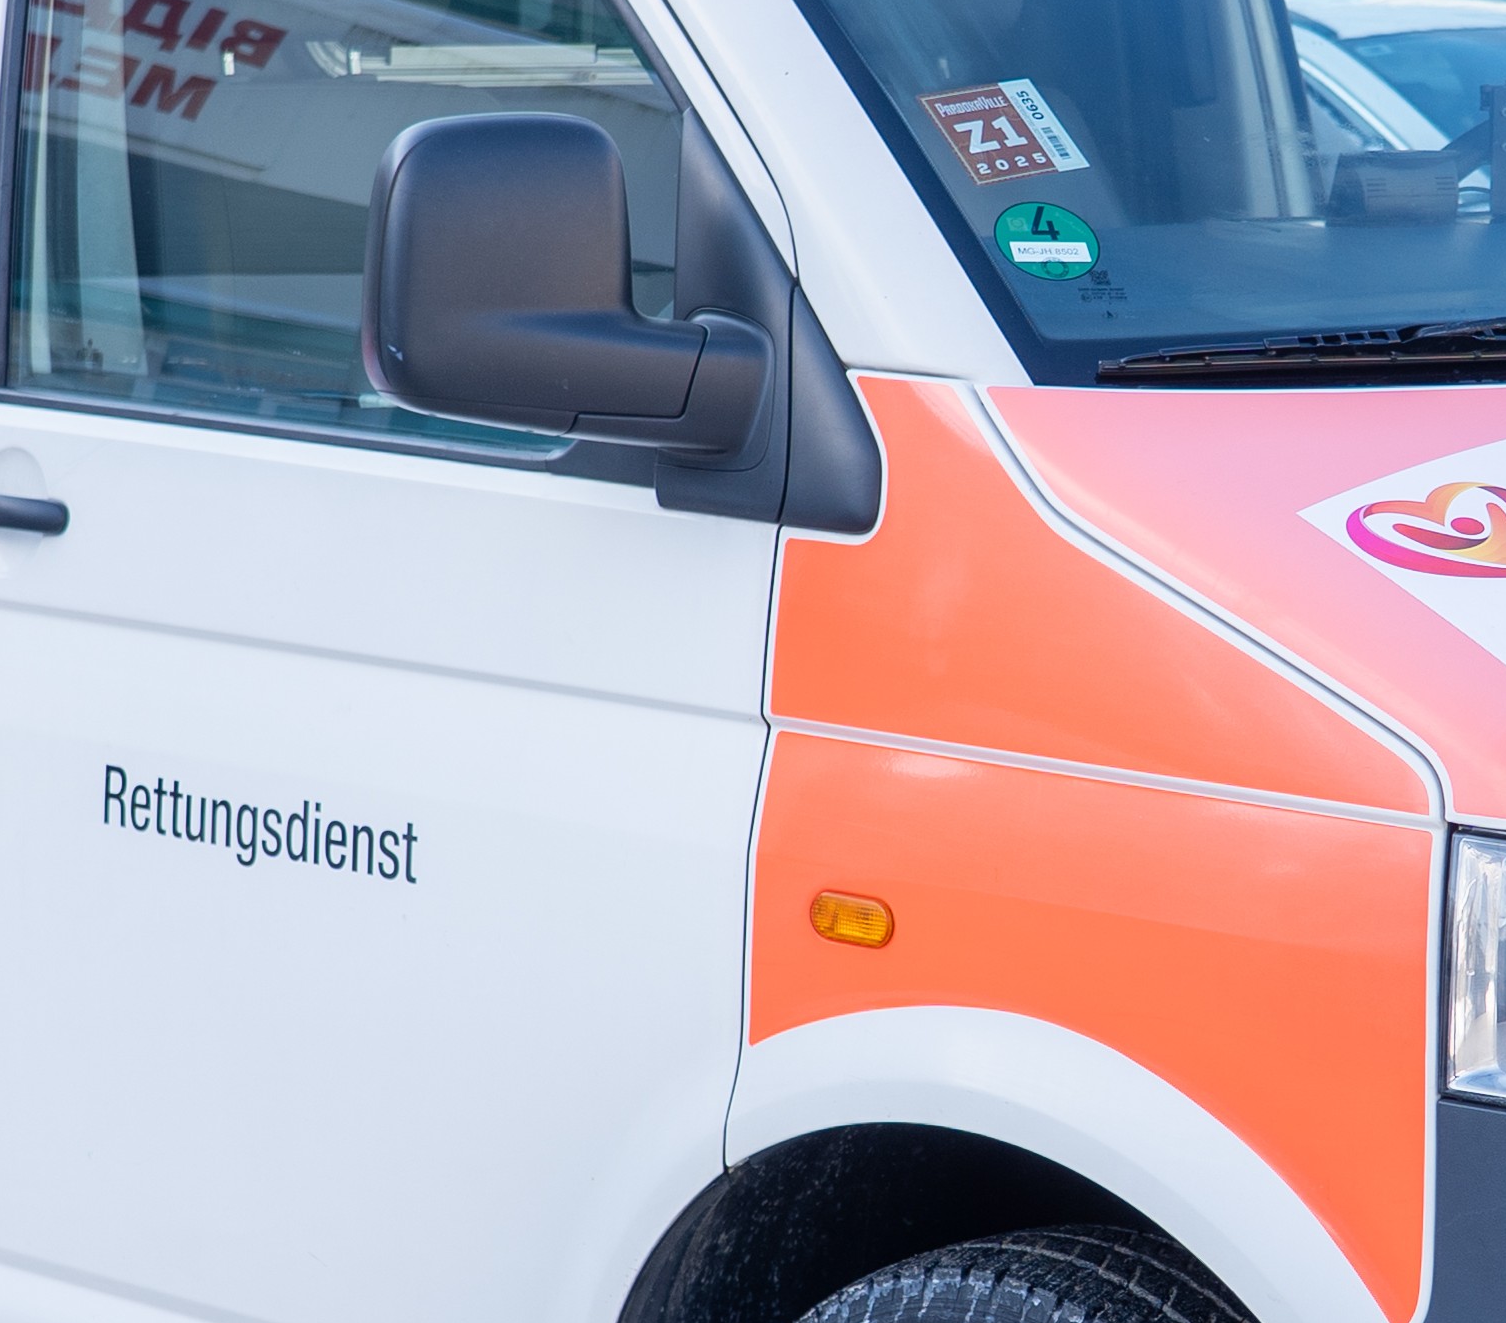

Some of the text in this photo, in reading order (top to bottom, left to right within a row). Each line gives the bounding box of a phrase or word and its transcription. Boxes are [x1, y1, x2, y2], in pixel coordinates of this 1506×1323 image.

[1016, 89, 1045, 121] 0635
[953, 115, 1028, 154] Z1
[976, 152, 1047, 175] 2025
[1031, 206, 1060, 241] 4
[104, 764, 418, 884] Rettungsdienst
